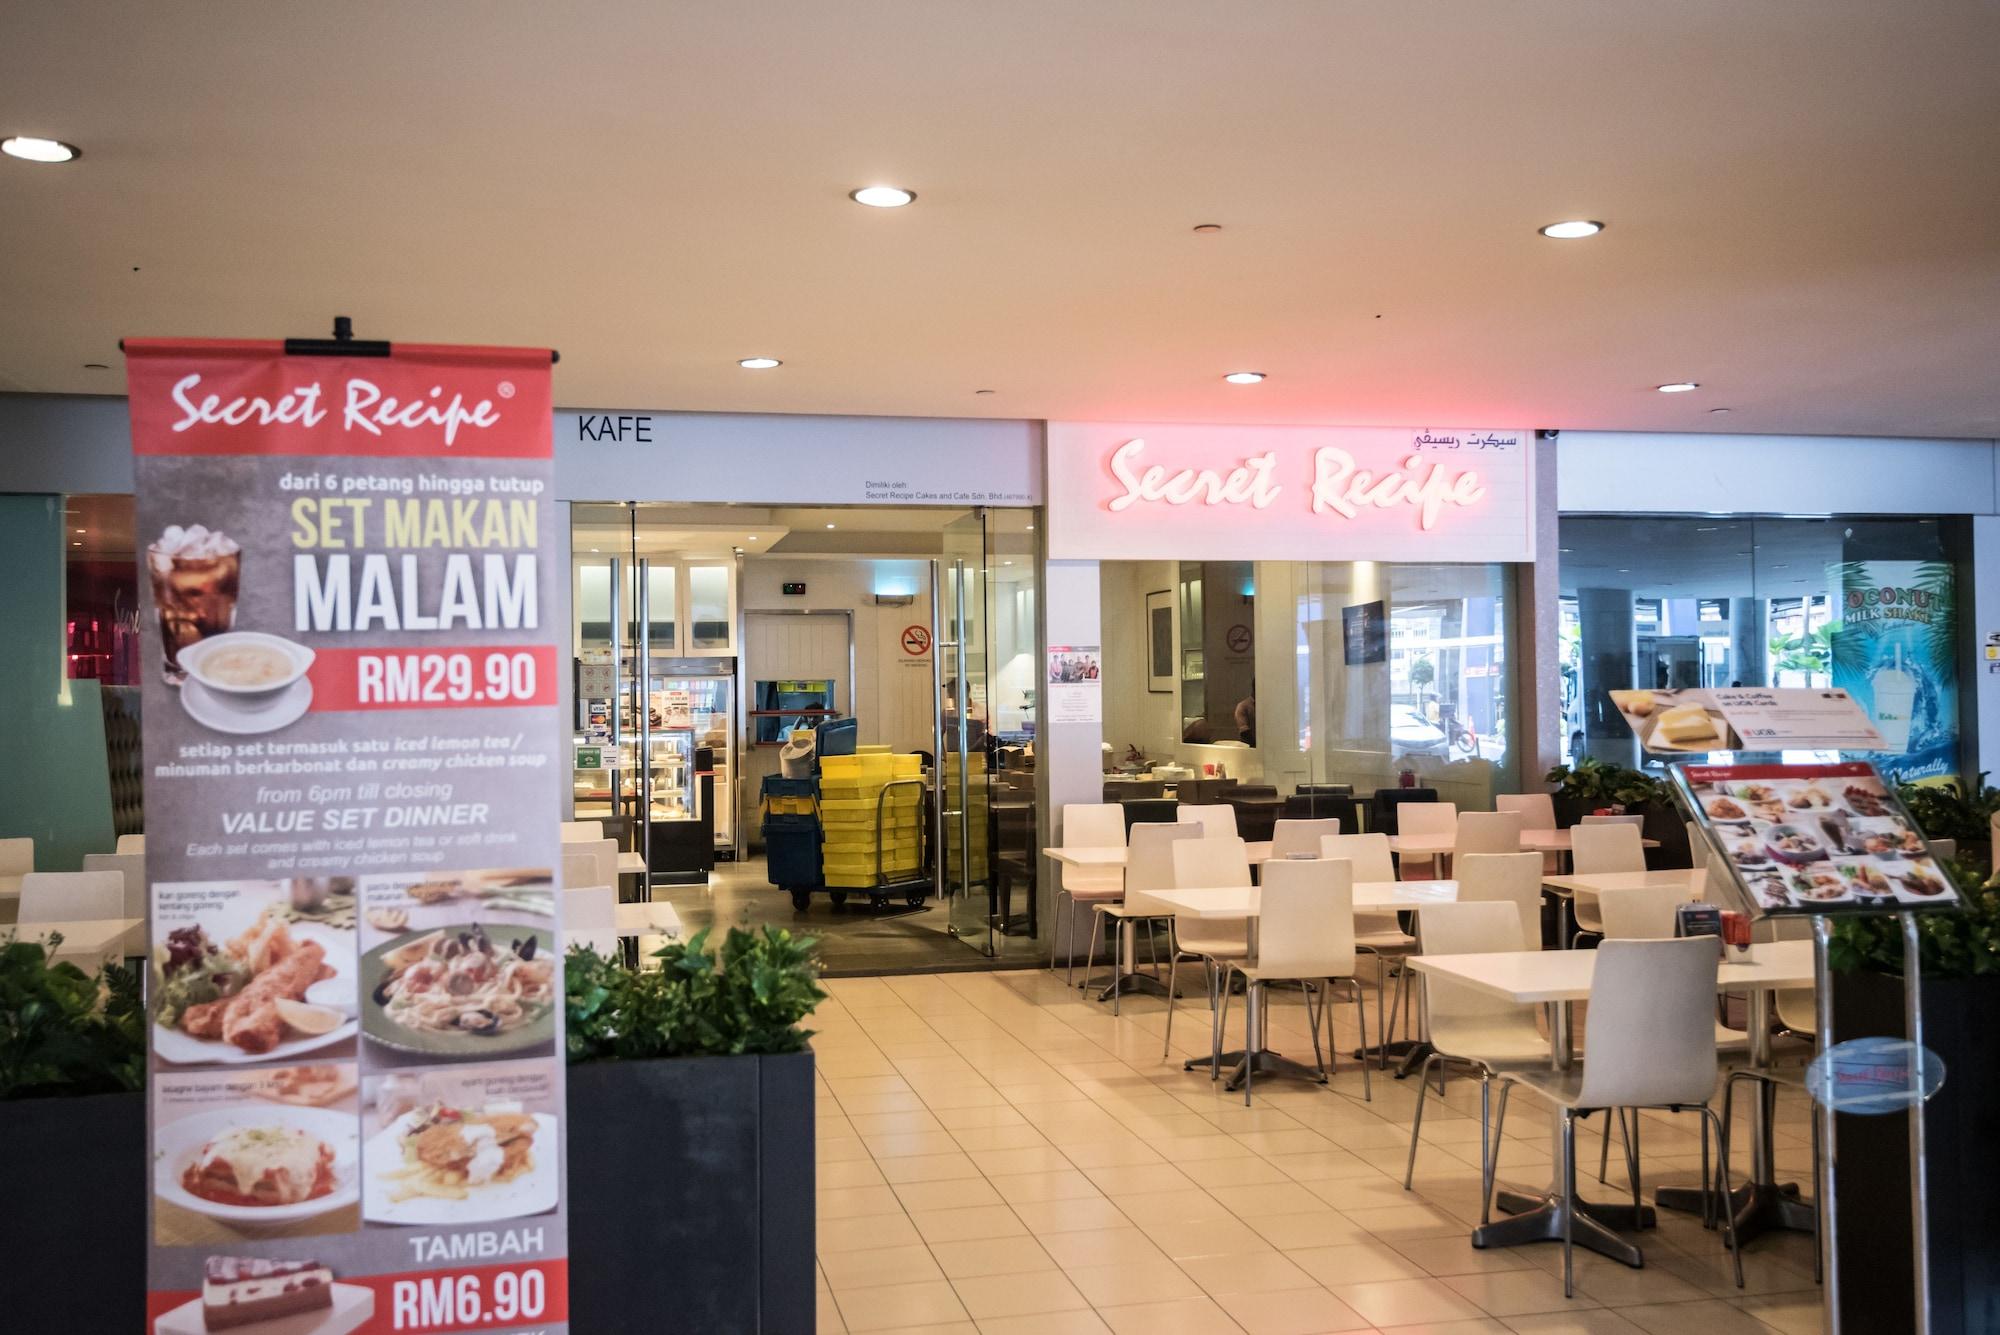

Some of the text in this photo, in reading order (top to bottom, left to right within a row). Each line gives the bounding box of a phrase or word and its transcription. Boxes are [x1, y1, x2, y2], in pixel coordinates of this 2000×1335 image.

[171, 374, 327, 433] Secret
[578, 415, 653, 442] KAFE
[279, 472, 544, 495] dari 6 petang hingga tutup
[866, 491, 888, 499] Secret
[890, 491, 914, 500] Recipe
[915, 492, 938, 500] Cakes
[939, 492, 952, 500] and
[1107, 438, 1487, 530] Secret Recipe
[291, 497, 538, 549] SET MAKAN
[294, 554, 539, 632] MALAM
[1845, 608, 1880, 625] MILK
[358, 652, 537, 703] RM29.90
[1753, 728, 1777, 737] UOB
[179, 741, 233, 760] setiap
[236, 742, 265, 756] set
[268, 738, 349, 756] termasuk
[352, 738, 389, 754] satu
[394, 736, 430, 752] iced
[431, 735, 481, 751] lemon
[155, 752, 548, 778] minuman berkarbonat dan creamy chicken soup
[256, 782, 454, 805] from 6pm till closing
[222, 803, 490, 835] VALUE SET DINNER
[409, 1226, 545, 1263] TAMBAH
[393, 1268, 546, 1330] RM6.90
